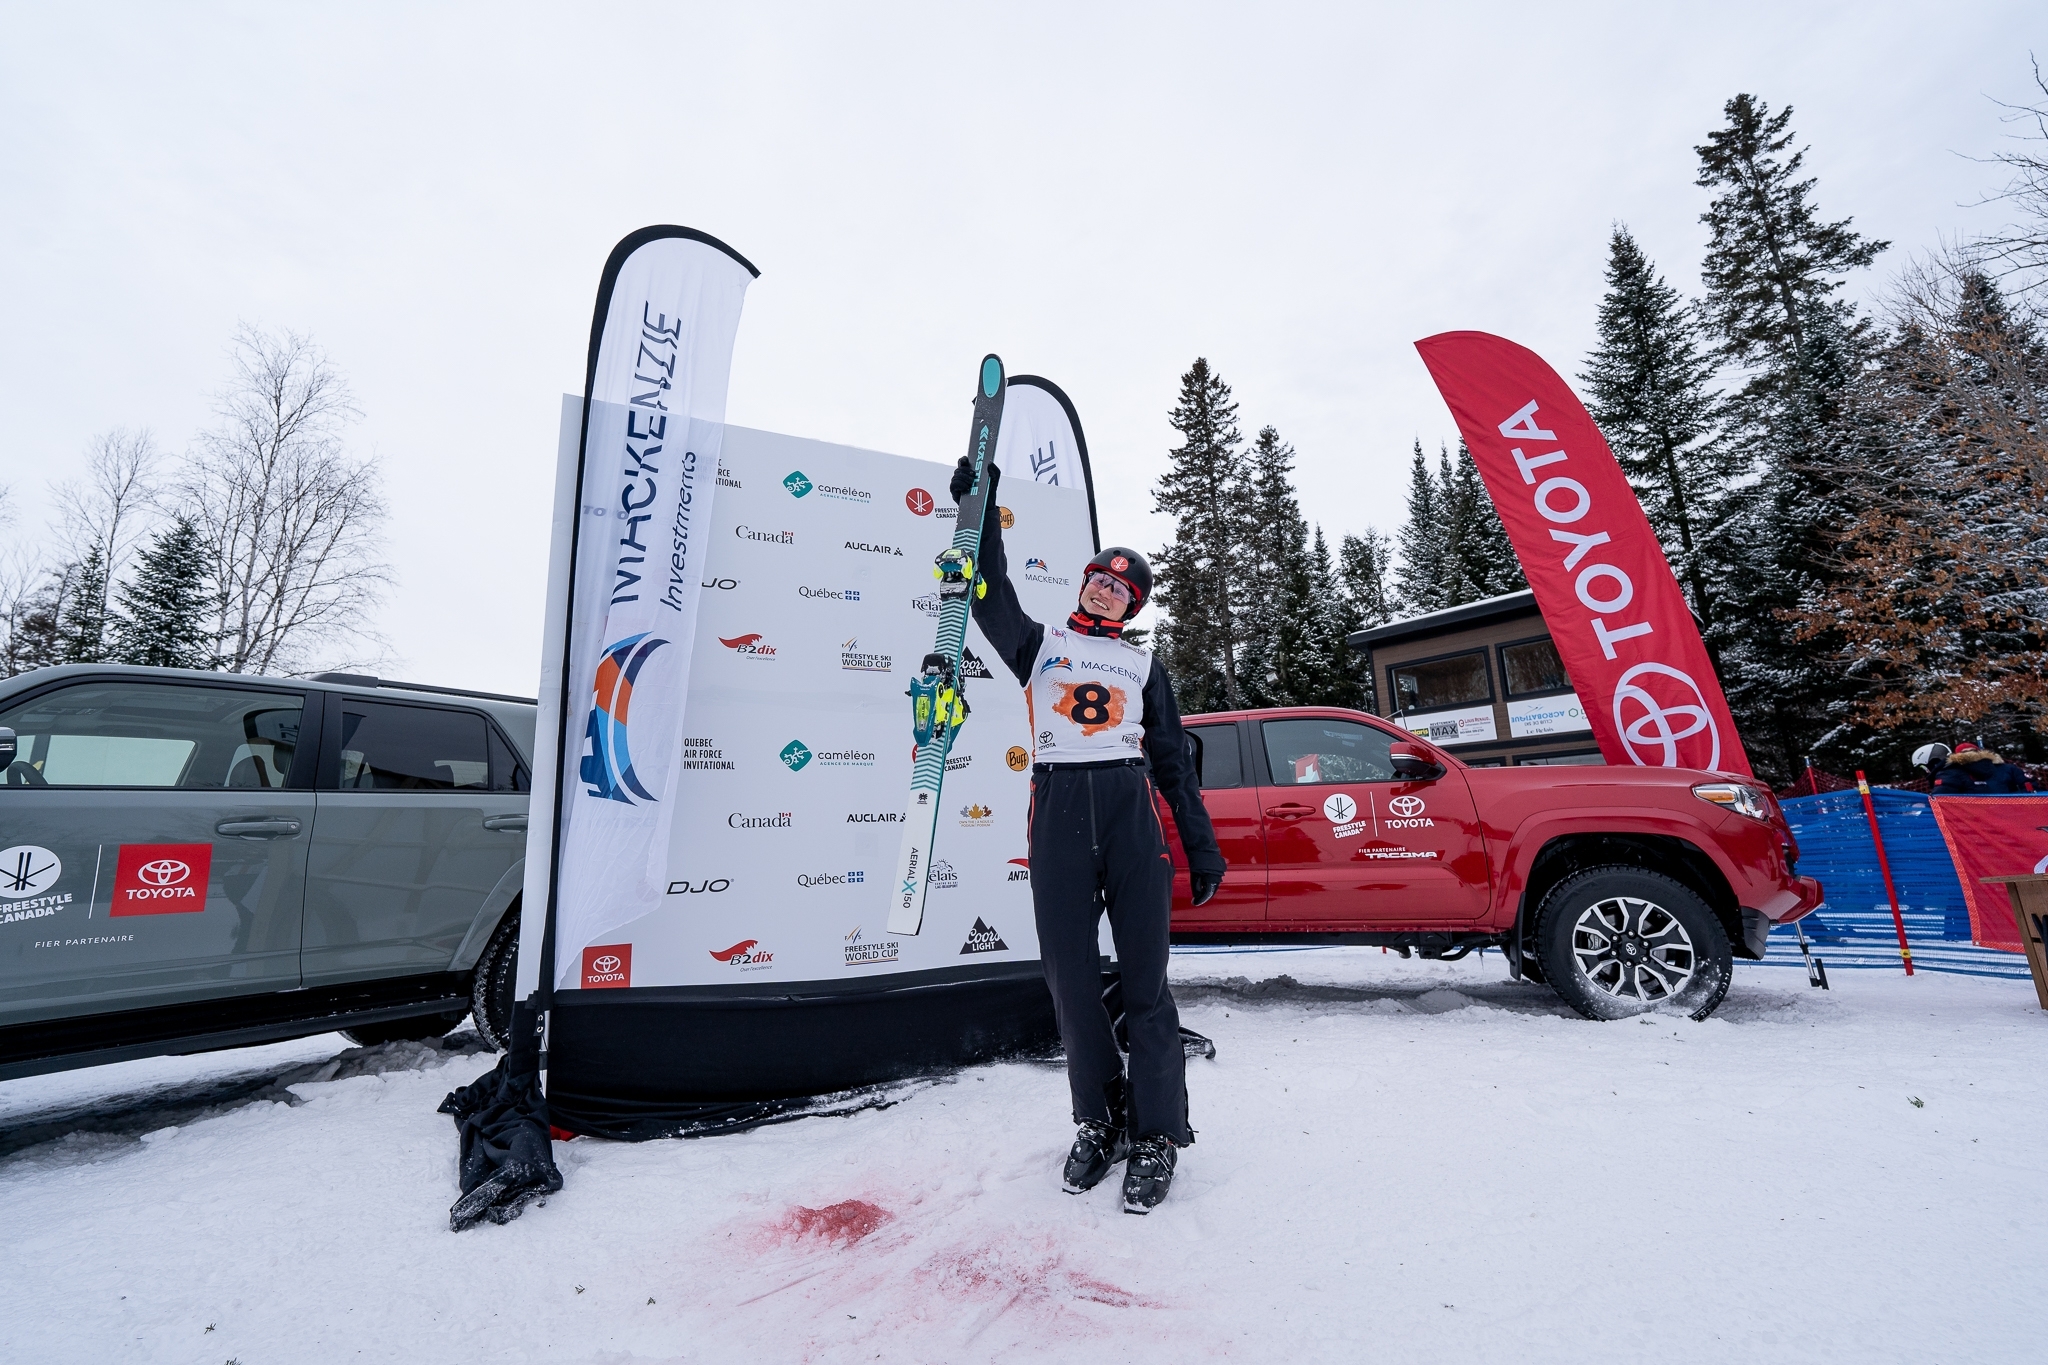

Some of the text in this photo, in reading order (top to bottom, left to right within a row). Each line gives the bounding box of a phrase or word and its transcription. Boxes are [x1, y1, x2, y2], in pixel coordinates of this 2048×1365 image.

[610, 300, 682, 607] MACKENZIE
[818, 484, 872, 499] caméléon
[659, 451, 697, 612] Investments
[735, 525, 794, 545] Canada
[1497, 398, 1654, 660] TOYOTA
[844, 541, 891, 554] AUCLAIR
[1025, 573, 1070, 586] MACKENZIE
[798, 586, 843, 600] Québec
[911, 599, 942, 611] Relai
[736, 644, 777, 656] B2dix
[841, 652, 879, 661] FREESTYLE
[841, 658, 892, 669] WORLD CUP
[960, 668, 982, 677] LIGHT
[1071, 684, 1111, 725] 8
[1511, 711, 1565, 723] ACROBATIQUE
[1431, 726, 1458, 737] MAX
[684, 738, 713, 748] QUEBEC
[1038, 742, 1056, 751] TOYOTA
[684, 749, 722, 759] AIR FORCE
[817, 750, 875, 761] caméléon
[683, 761, 735, 770] INVITATIONAL
[945, 755, 972, 766] REESTYLE
[944, 763, 966, 772] CANADA
[727, 812, 792, 829] Canada
[846, 813, 897, 823] AUCLAIR
[1385, 818, 1434, 829] TOYOTA
[1333, 820, 1366, 833] FREESTYLE
[1334, 829, 1360, 839] CANADA
[1364, 851, 1438, 859] TACOMA
[797, 873, 846, 887] Québec
[928, 870, 958, 882] elais
[1007, 871, 1029, 881] ANTA
[666, 878, 731, 895] DJO
[126, 887, 195, 900] TOYOTA
[35, 934, 134, 948] FIER PARTENAIRE
[967, 929, 1000, 944] Coors
[844, 943, 885, 953] FREESTYLE
[972, 942, 995, 952] LIGHT
[730, 951, 774, 966] B2dix
[844, 949, 899, 962] WORLD CUP
[587, 973, 625, 983] TOYOTA
